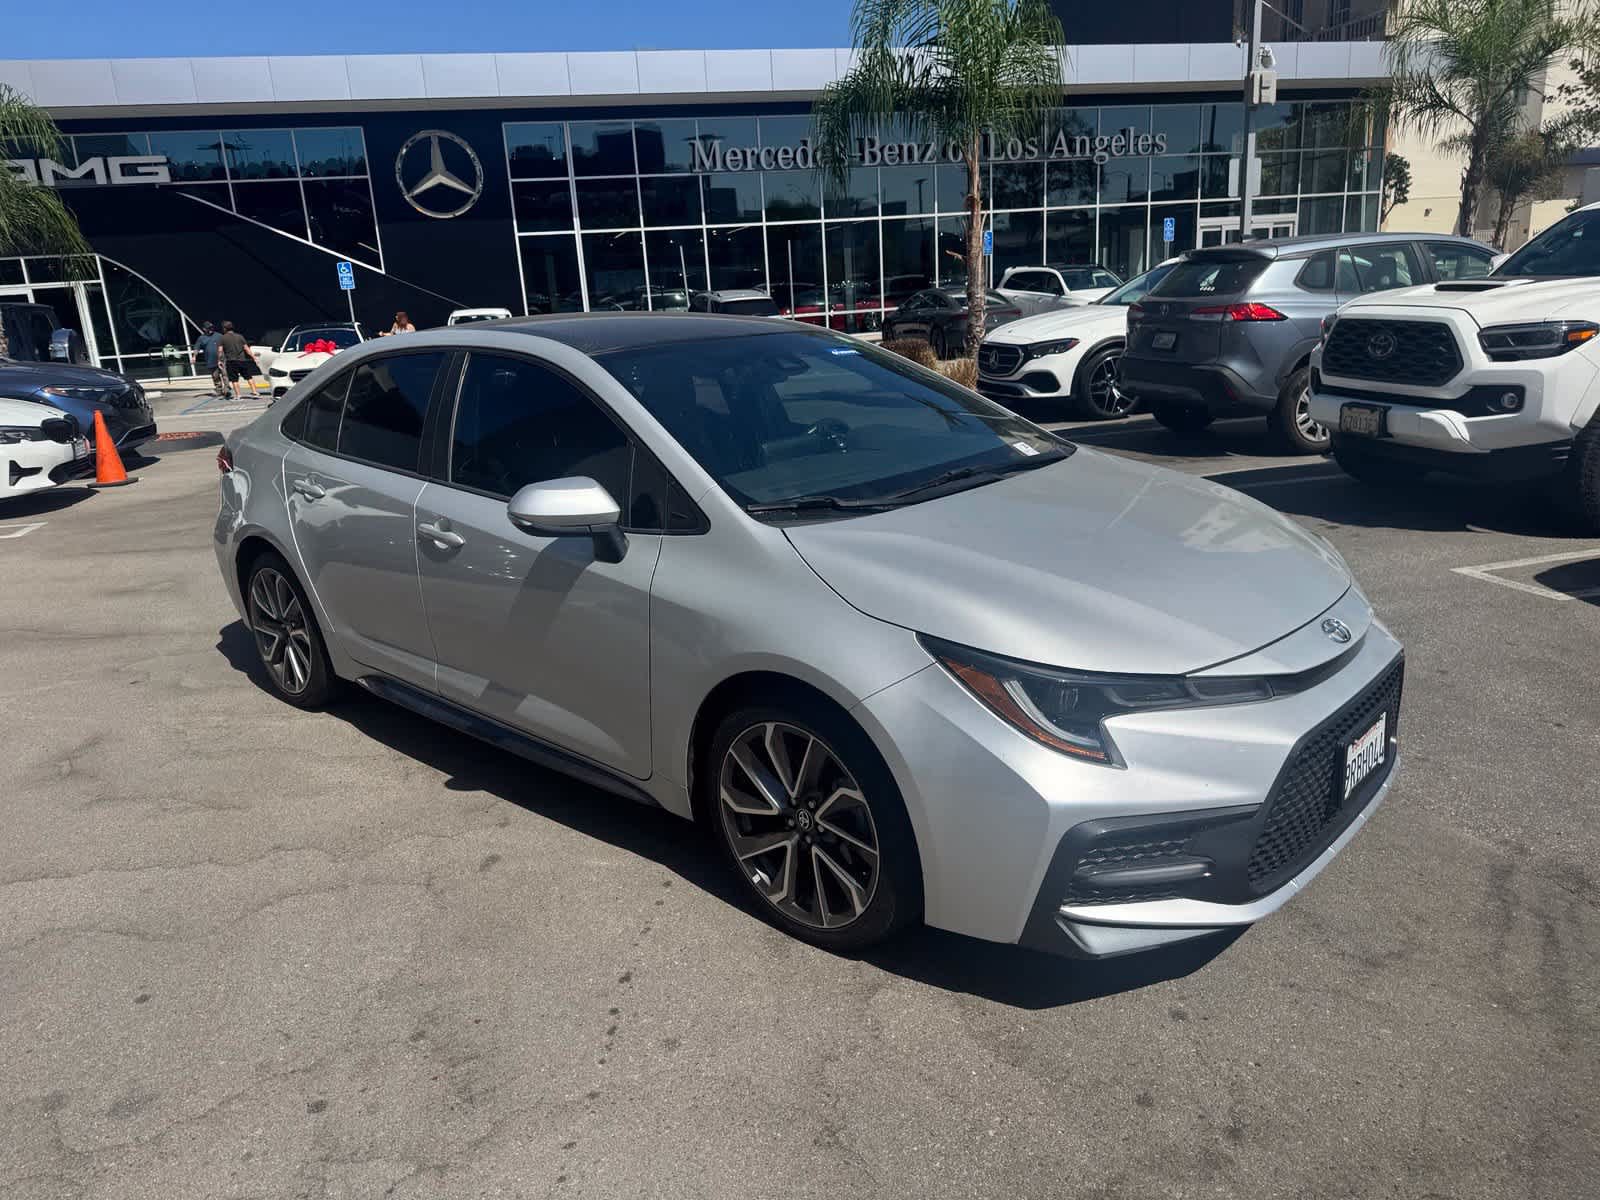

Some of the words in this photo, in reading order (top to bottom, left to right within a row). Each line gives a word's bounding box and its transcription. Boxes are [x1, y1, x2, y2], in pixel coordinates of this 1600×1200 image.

[690, 135, 936, 173] Merced-Benz
[987, 128, 1038, 161] Los
[1049, 126, 1167, 164] Angeles
[4, 154, 171, 186] AMG
